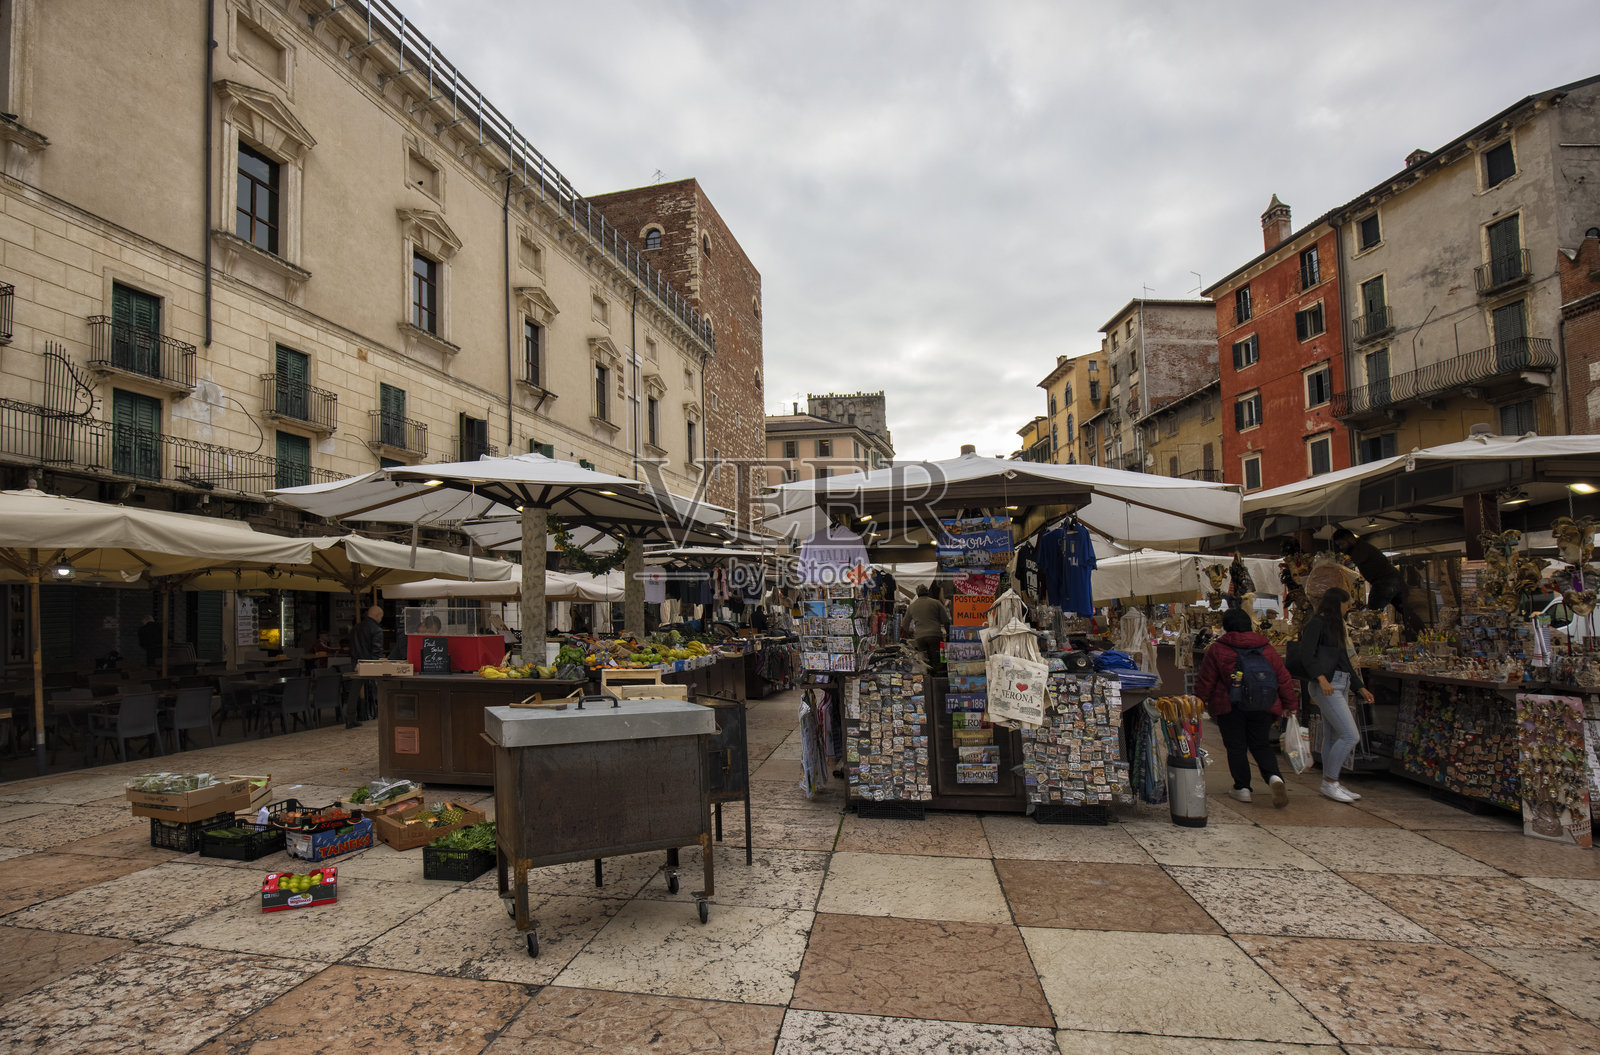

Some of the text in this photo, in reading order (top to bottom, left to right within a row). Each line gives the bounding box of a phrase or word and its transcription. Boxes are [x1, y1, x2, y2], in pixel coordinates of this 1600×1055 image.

[813, 549, 852, 562] ITALIA
[954, 595, 994, 603] POSTCARDS
[1008, 680, 1012, 690] I
[1002, 689, 1033, 704] VERONA
[947, 698, 960, 709] ITA
[319, 833, 371, 858] TANEKS
